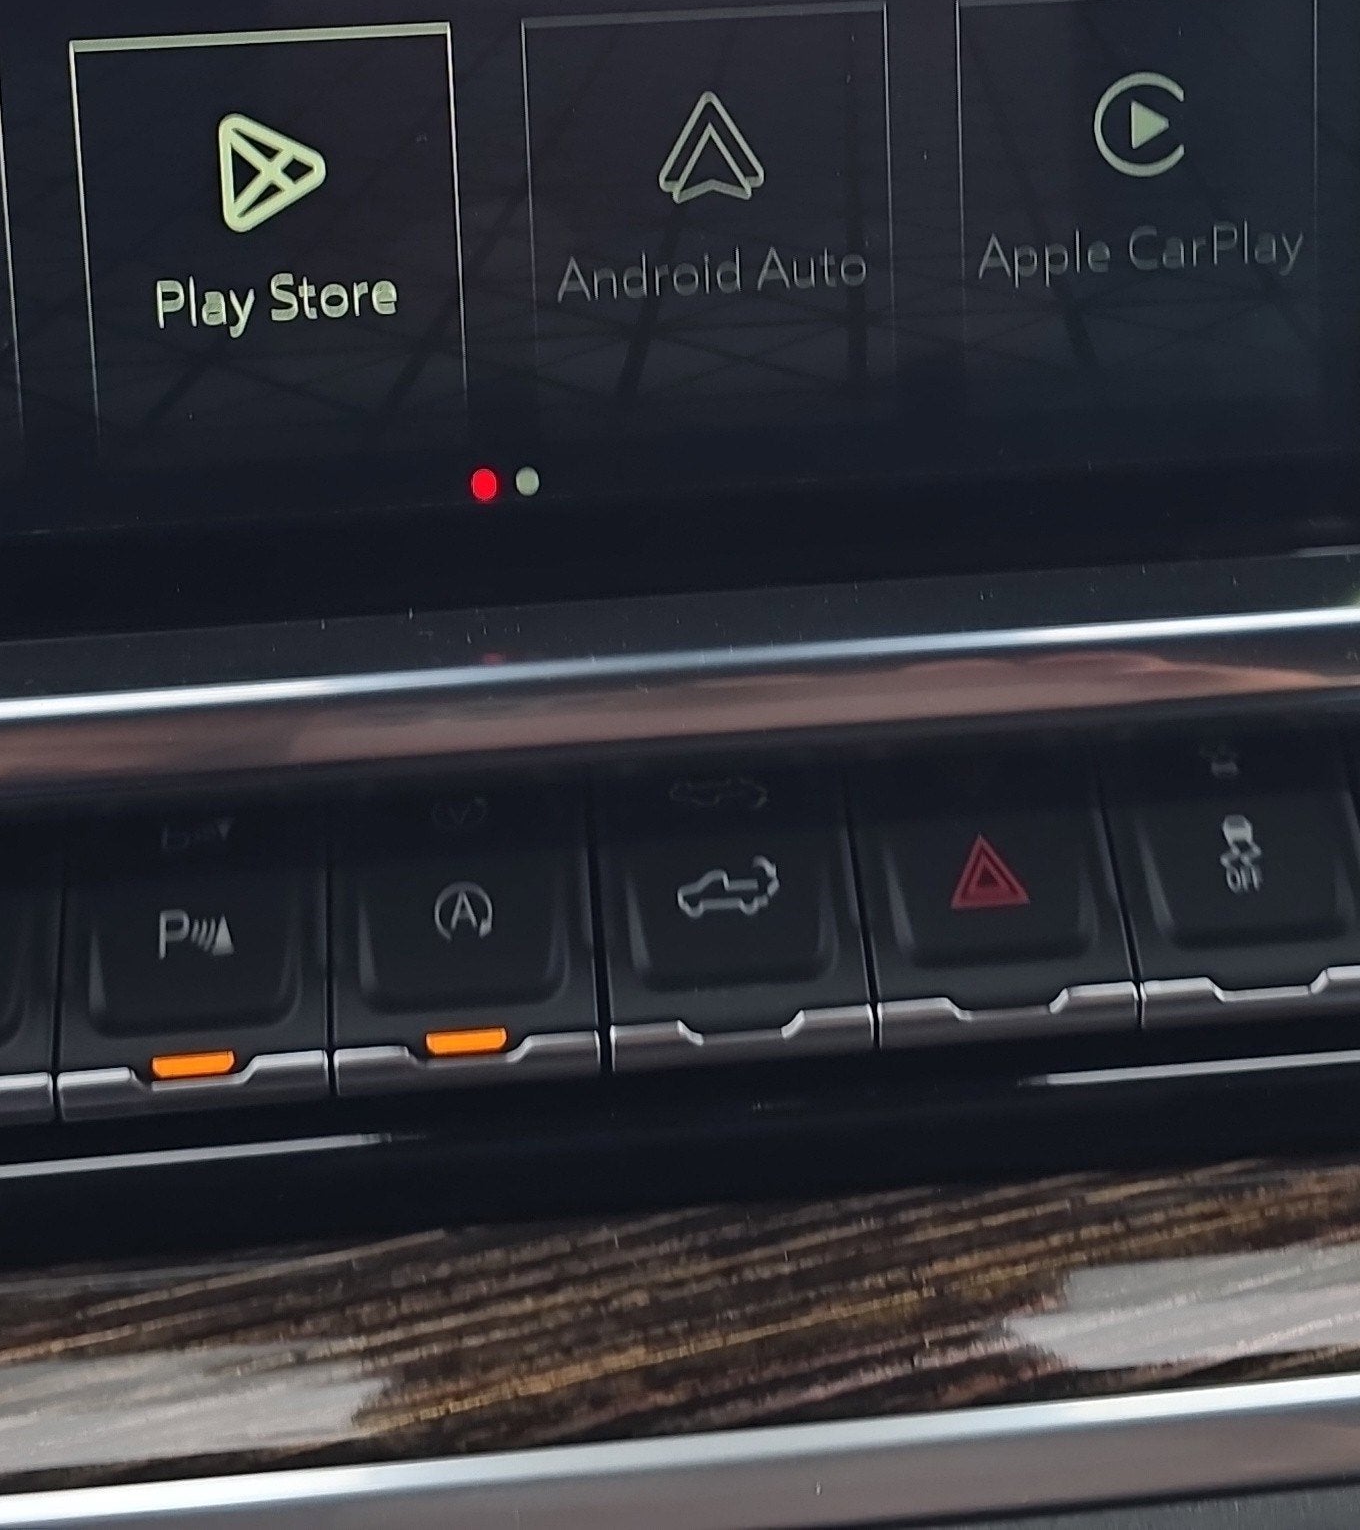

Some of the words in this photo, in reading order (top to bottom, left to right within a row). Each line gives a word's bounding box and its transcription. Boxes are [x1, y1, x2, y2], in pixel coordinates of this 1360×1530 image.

[557, 247, 742, 303] Android
[757, 247, 867, 291] Auto
[978, 229, 1110, 288] Apple
[1128, 220, 1304, 276] CarPlay
[156, 276, 255, 338] Play
[269, 273, 397, 322] Store
[159, 909, 190, 960] P
